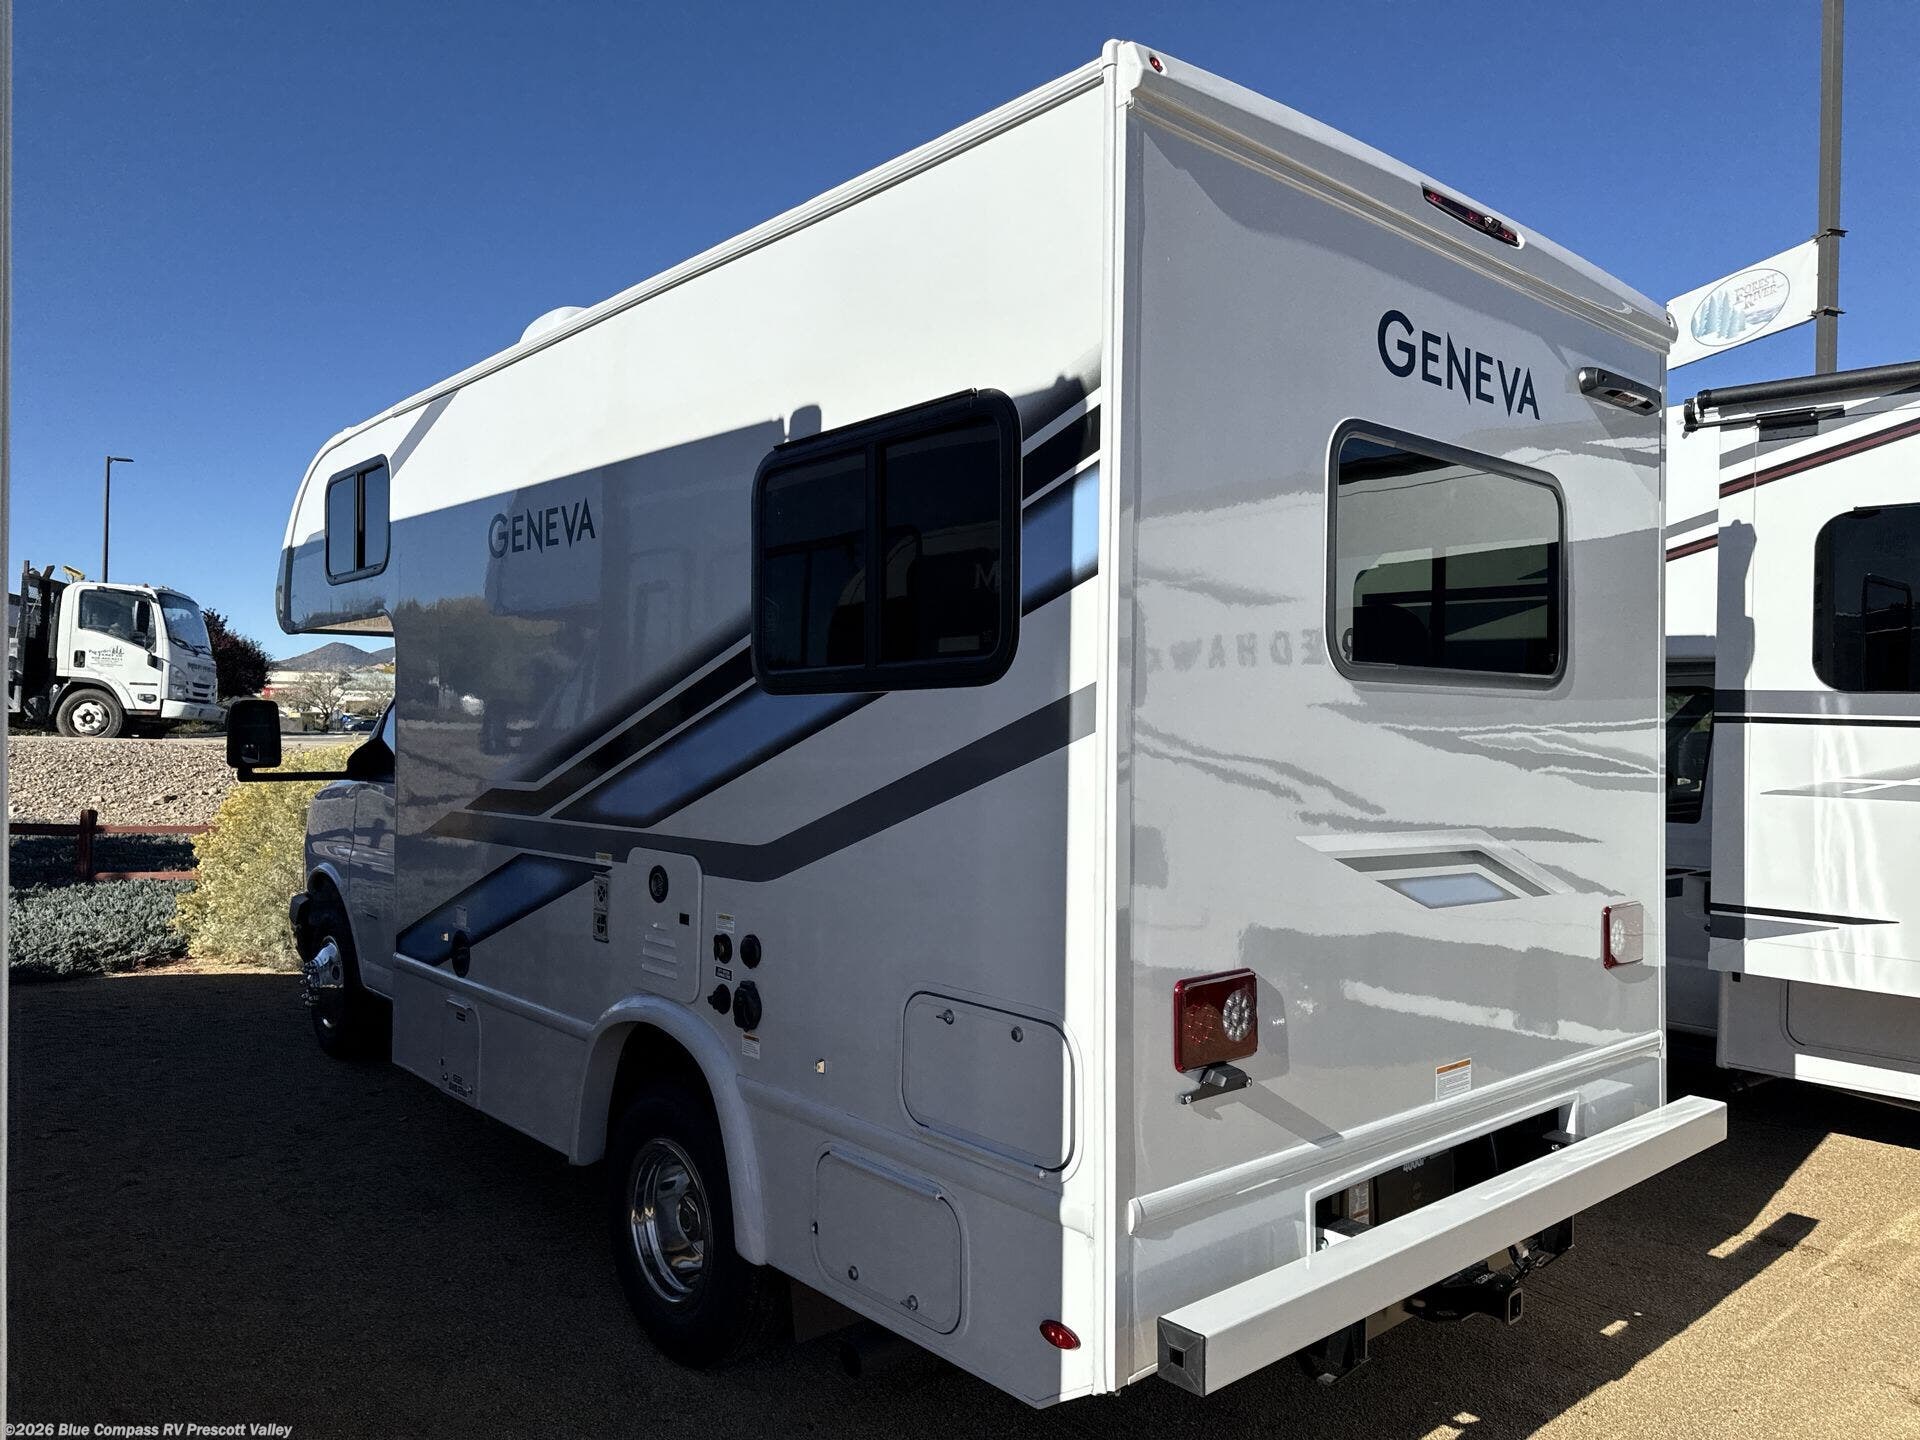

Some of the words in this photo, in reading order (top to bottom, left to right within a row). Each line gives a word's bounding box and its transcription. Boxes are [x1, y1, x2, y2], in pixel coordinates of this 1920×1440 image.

[1734, 273, 1777, 301] FOREST
[1744, 284, 1777, 309] RIVER
[1377, 309, 1541, 421] GENEVA
[488, 497, 596, 559] GENEVA
